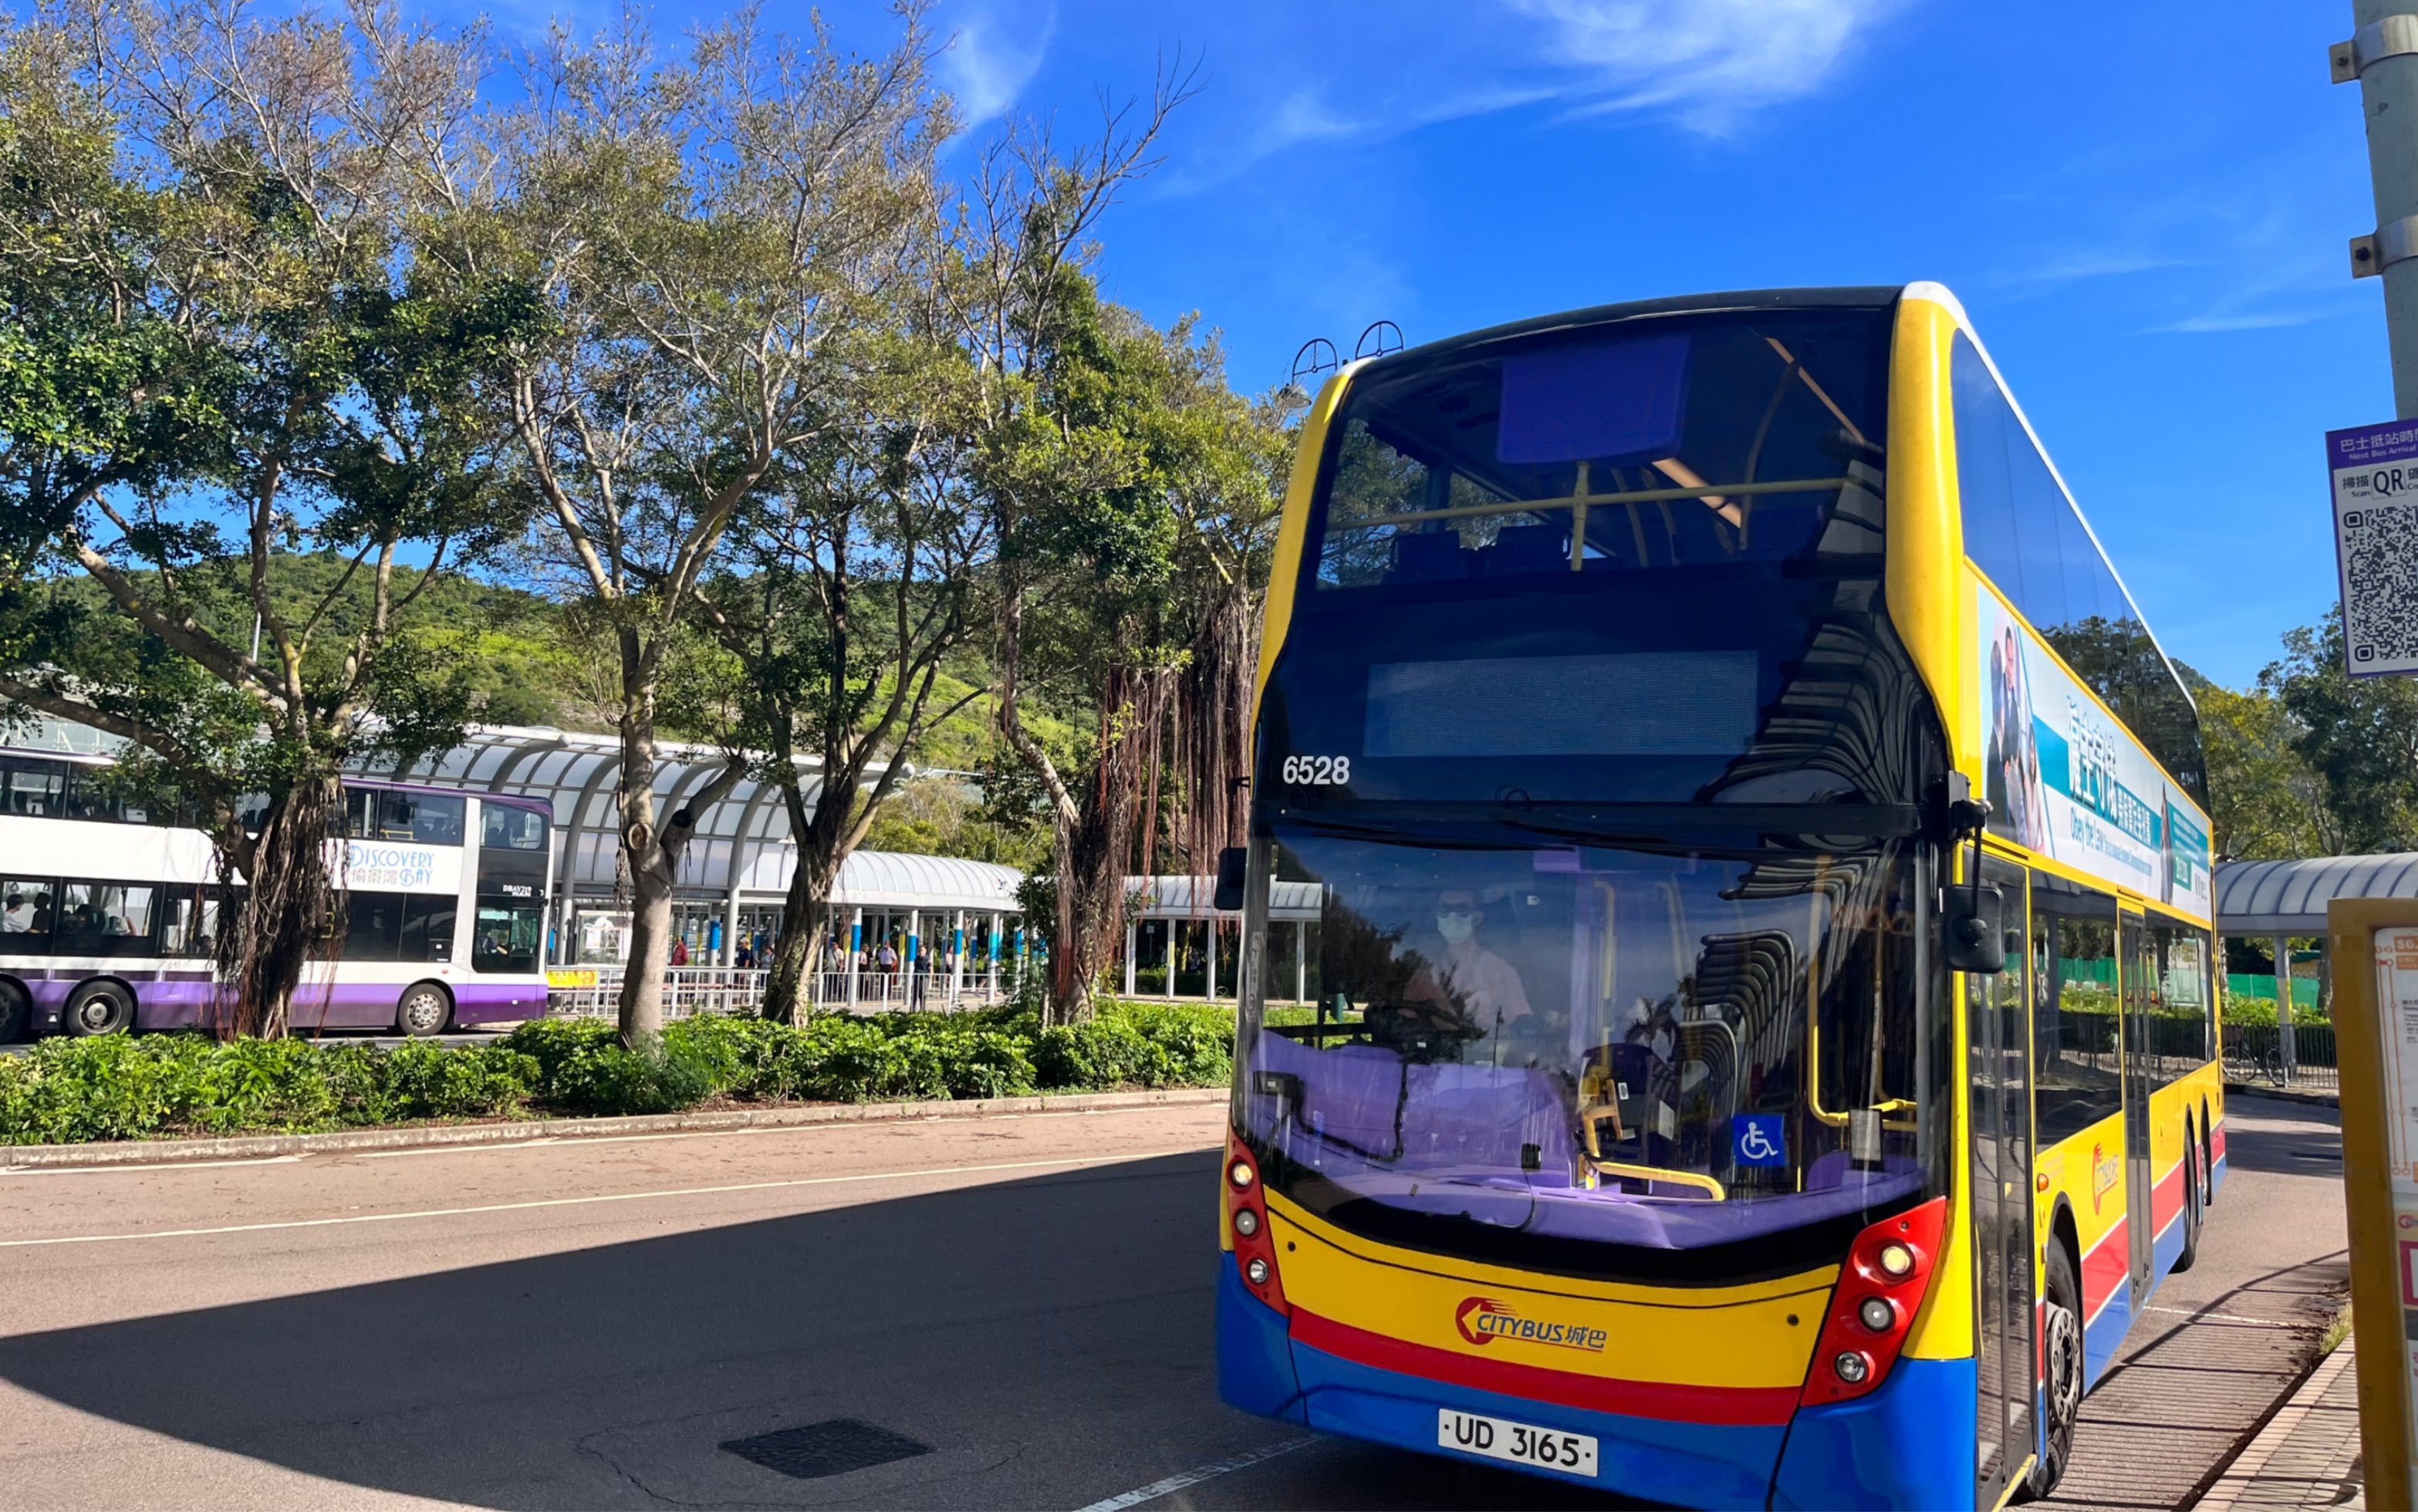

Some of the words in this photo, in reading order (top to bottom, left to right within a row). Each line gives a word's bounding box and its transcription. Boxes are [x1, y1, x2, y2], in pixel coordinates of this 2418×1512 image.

[2349, 452, 2369, 461] Next
[2389, 444, 2416, 454] Arrival
[2342, 474, 2369, 490] 掃描
[2373, 469, 2405, 497] QR
[1282, 755, 1350, 785] 6528
[350, 845, 435, 868] DISCOVERY
[400, 869, 434, 886] BAY
[352, 868, 399, 886] 愉景灣
[1477, 1313, 1565, 1342] CITYBUS
[1566, 1325, 1607, 1349] 城巴
[1455, 1415, 1494, 1450] UD
[1509, 1427, 1580, 1467] 3165
